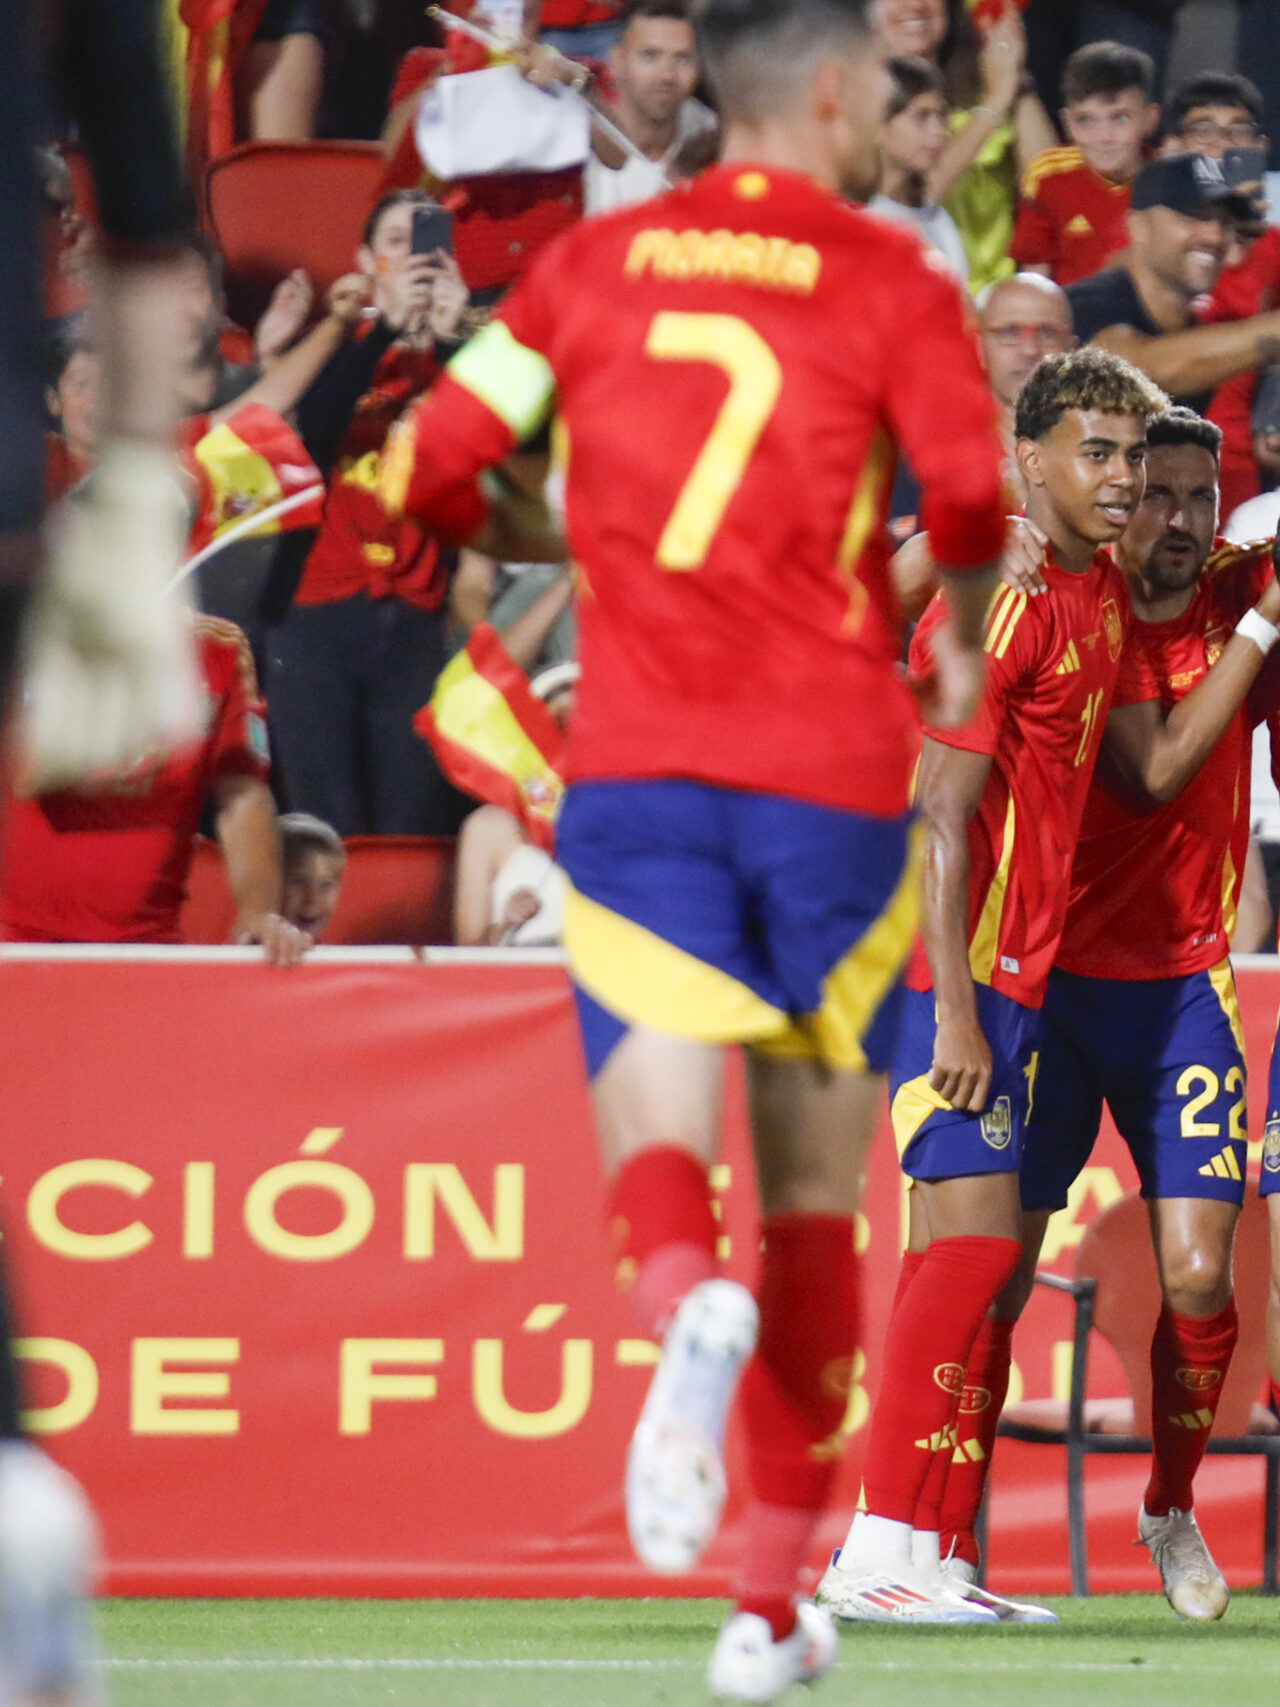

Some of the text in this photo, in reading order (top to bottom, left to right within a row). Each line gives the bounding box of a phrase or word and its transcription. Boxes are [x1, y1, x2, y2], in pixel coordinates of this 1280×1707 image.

[646, 311, 783, 571] 7
[1176, 1064, 1248, 1141] 22
[0, 1127, 525, 1262] CIÓN
[12, 1336, 241, 1436] DE
